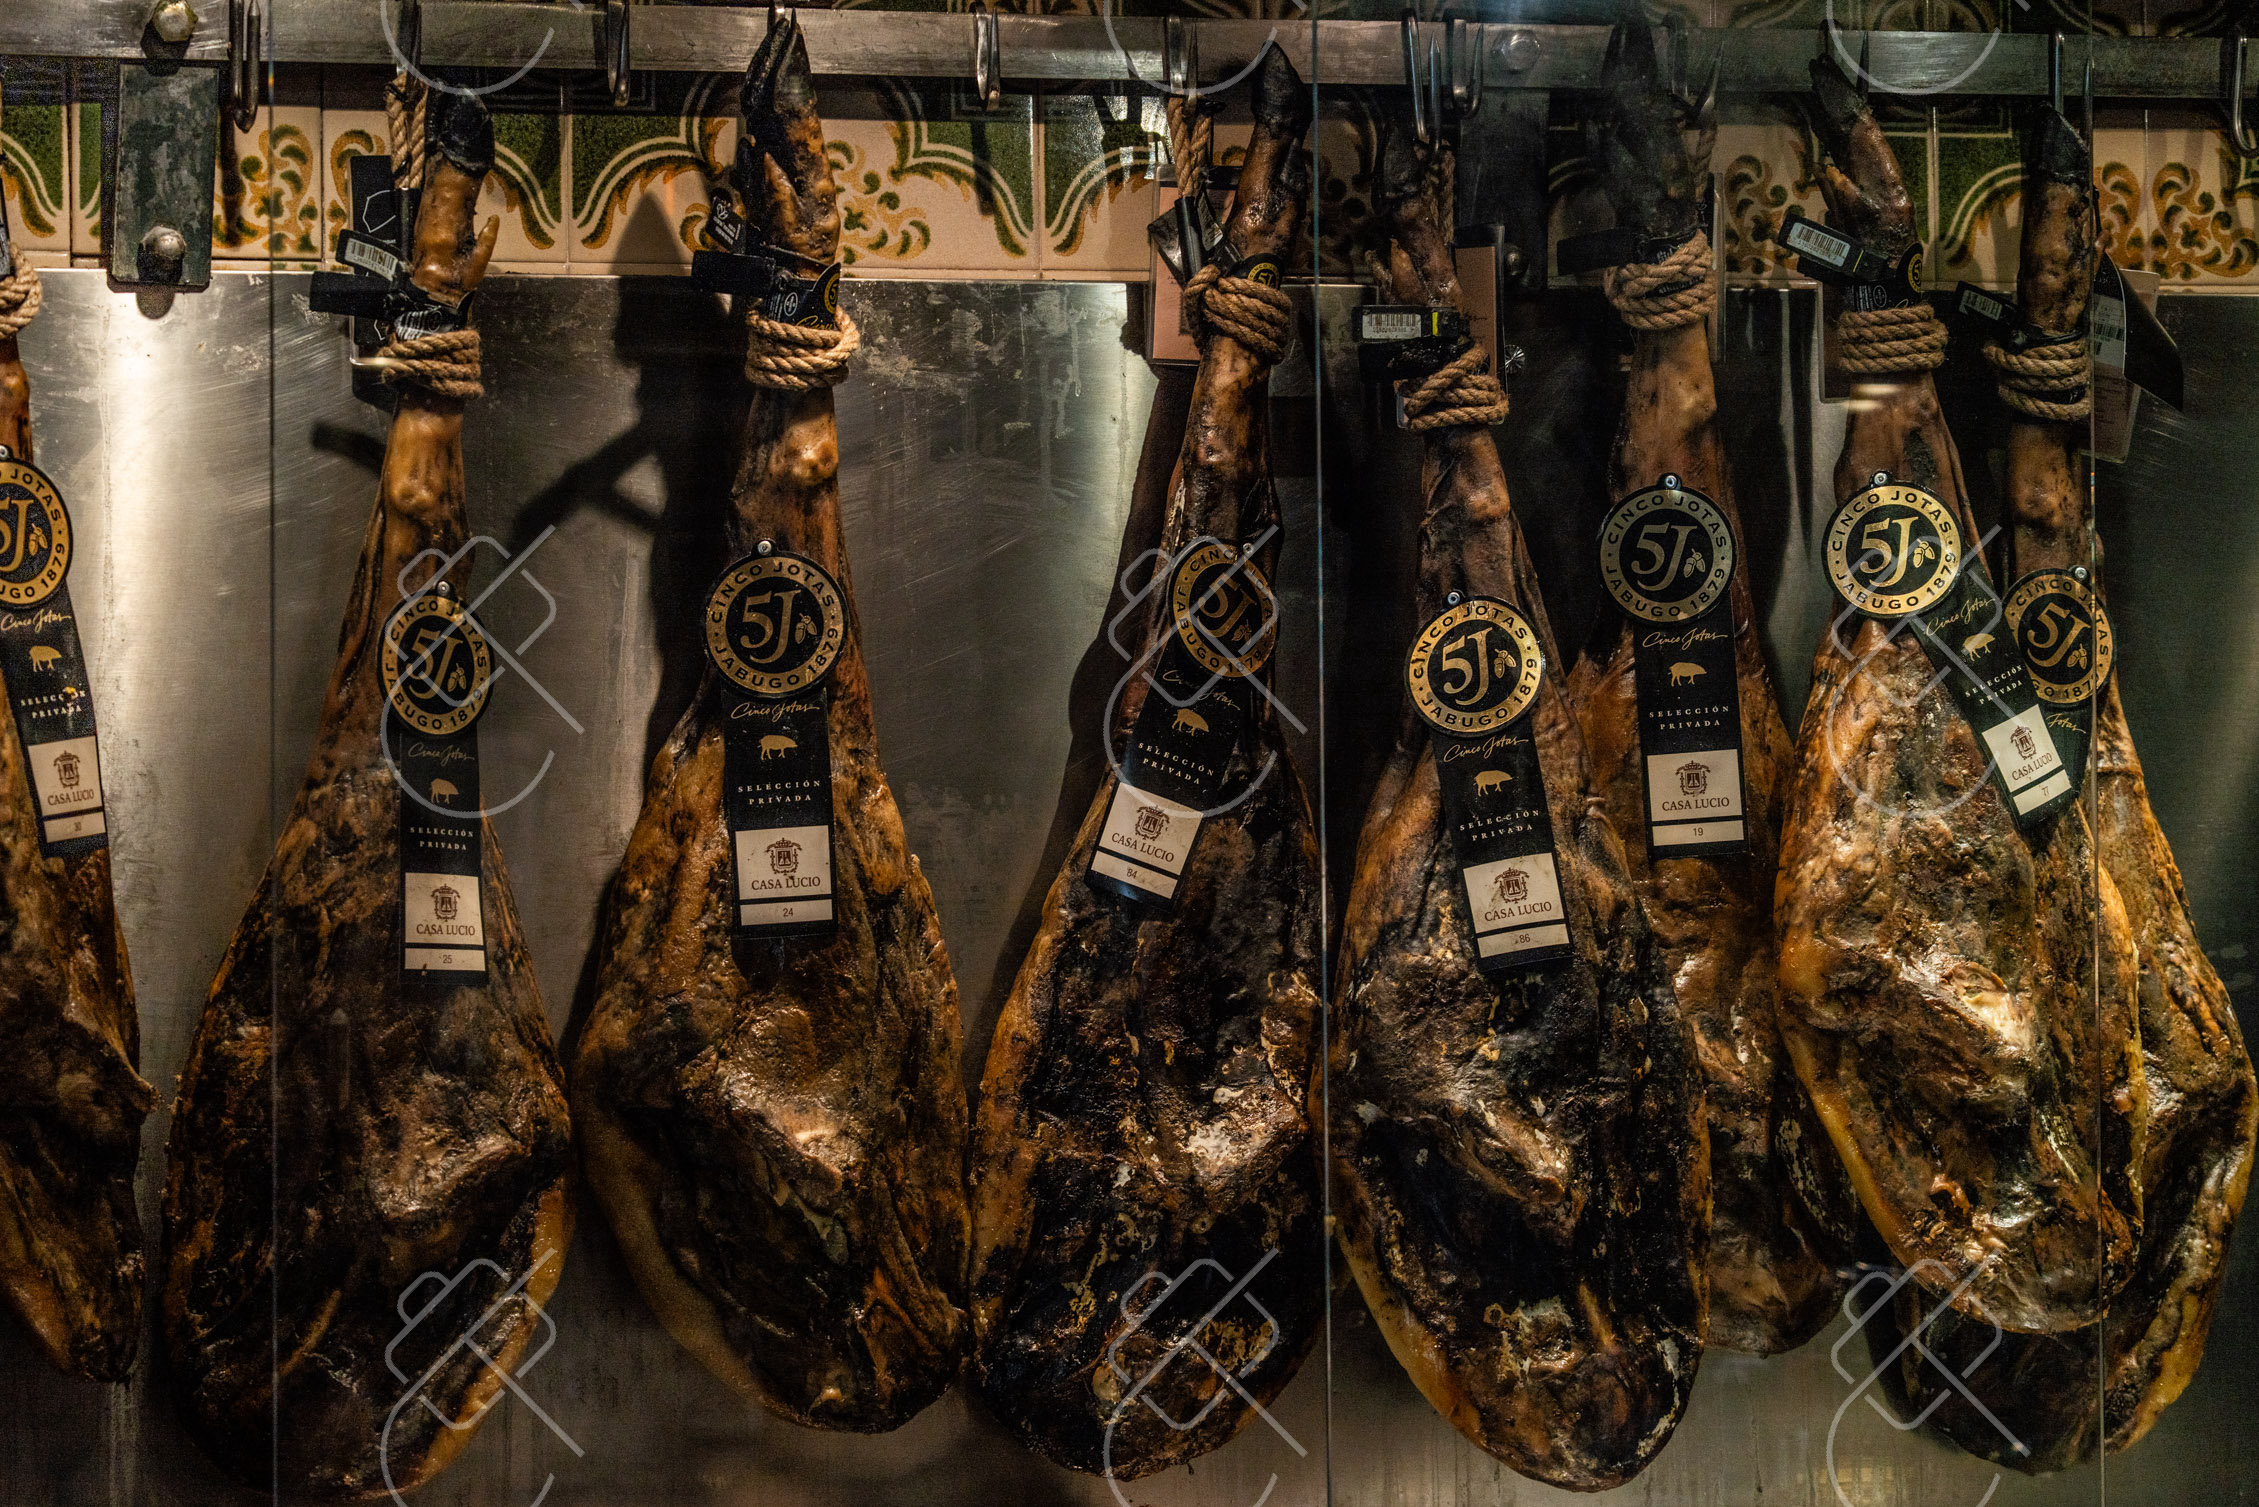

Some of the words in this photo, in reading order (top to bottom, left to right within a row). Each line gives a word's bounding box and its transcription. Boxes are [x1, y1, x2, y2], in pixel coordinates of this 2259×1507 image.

[10, 468, 61, 521] JOTAS
[1607, 495, 1664, 545] CINCO
[1674, 496, 1727, 548] JOTAS
[1832, 493, 1880, 552] CINCO
[1890, 490, 1951, 533] JOTAS
[41, 543, 65, 588] 1879
[1630, 521, 1698, 592] 5J
[1859, 516, 1919, 588] 5J
[711, 564, 763, 624] CINCO
[773, 561, 835, 607] JOTAS
[1606, 565, 1681, 617] JABUGO
[1690, 568, 1725, 610] 1879
[1836, 573, 1919, 610] JABUGO
[1926, 552, 1956, 597] 1879
[2016, 579, 2072, 606] CINCO
[1197, 572, 1258, 638] 5J
[1926, 613, 1959, 636] Cinco
[1960, 597, 1996, 625] Jotas
[391, 600, 439, 641] CINCO
[739, 589, 802, 664] 5J
[1176, 586, 1221, 669] JABUGO
[2027, 601, 2092, 668] 5J
[1412, 616, 1454, 679] CINCO
[1463, 605, 1528, 640] JOTAS
[1642, 631, 1681, 648] Cinco
[1682, 627, 1729, 650] Jotas
[405, 628, 464, 700] 5J
[715, 645, 800, 689] JABUGO
[807, 627, 839, 674] 1879
[1442, 627, 1493, 706] 5J
[1421, 699, 1508, 728] JABUGO
[1513, 658, 1538, 706] 1879
[1965, 664, 2022, 698] SELECCIÓN
[1979, 680, 2023, 705] PRIVADA
[385, 663, 443, 730] JABUGO
[450, 688, 483, 727] 1879
[730, 702, 770, 719] Cinco
[771, 700, 820, 723] Jotas
[1649, 705, 1729, 718] SELECCIÓN
[1660, 719, 1720, 730] PRIVADA
[1138, 742, 1214, 777] SELECCIÓN
[1443, 744, 1481, 763] Cinco
[1482, 734, 1529, 760] Jotas
[1143, 758, 1201, 785] PRIVADA
[2011, 763, 2034, 781] CASA
[2032, 752, 2053, 770] LUCIO
[47, 793, 72, 806] CASA
[72, 788, 95, 802] LUCIO
[737, 778, 821, 793] SELECCIÓN
[749, 793, 812, 805] PRIVADA
[2041, 785, 2050, 797] 77
[1662, 800, 1692, 812] CASA
[1695, 796, 1730, 809] LUCIO
[410, 827, 475, 838] SELECCIÓN
[1459, 809, 1541, 832] SELECCIÓN
[1472, 824, 1533, 842] PRIVADA
[1693, 827, 1704, 837] 19
[419, 840, 468, 851] PRIVADA
[1111, 832, 1139, 850] CASA
[1140, 842, 1175, 863] LUCIO
[751, 878, 783, 891] CASA
[785, 876, 821, 889] LUCIO
[1126, 868, 1138, 880] 84
[782, 907, 794, 917] 24
[1484, 909, 1516, 922] CASA
[1518, 901, 1552, 916] LUCIO
[416, 923, 444, 936] CASA
[446, 924, 476, 937] LUCIO
[1519, 933, 1531, 944] 86
[442, 954, 453, 964] 25
